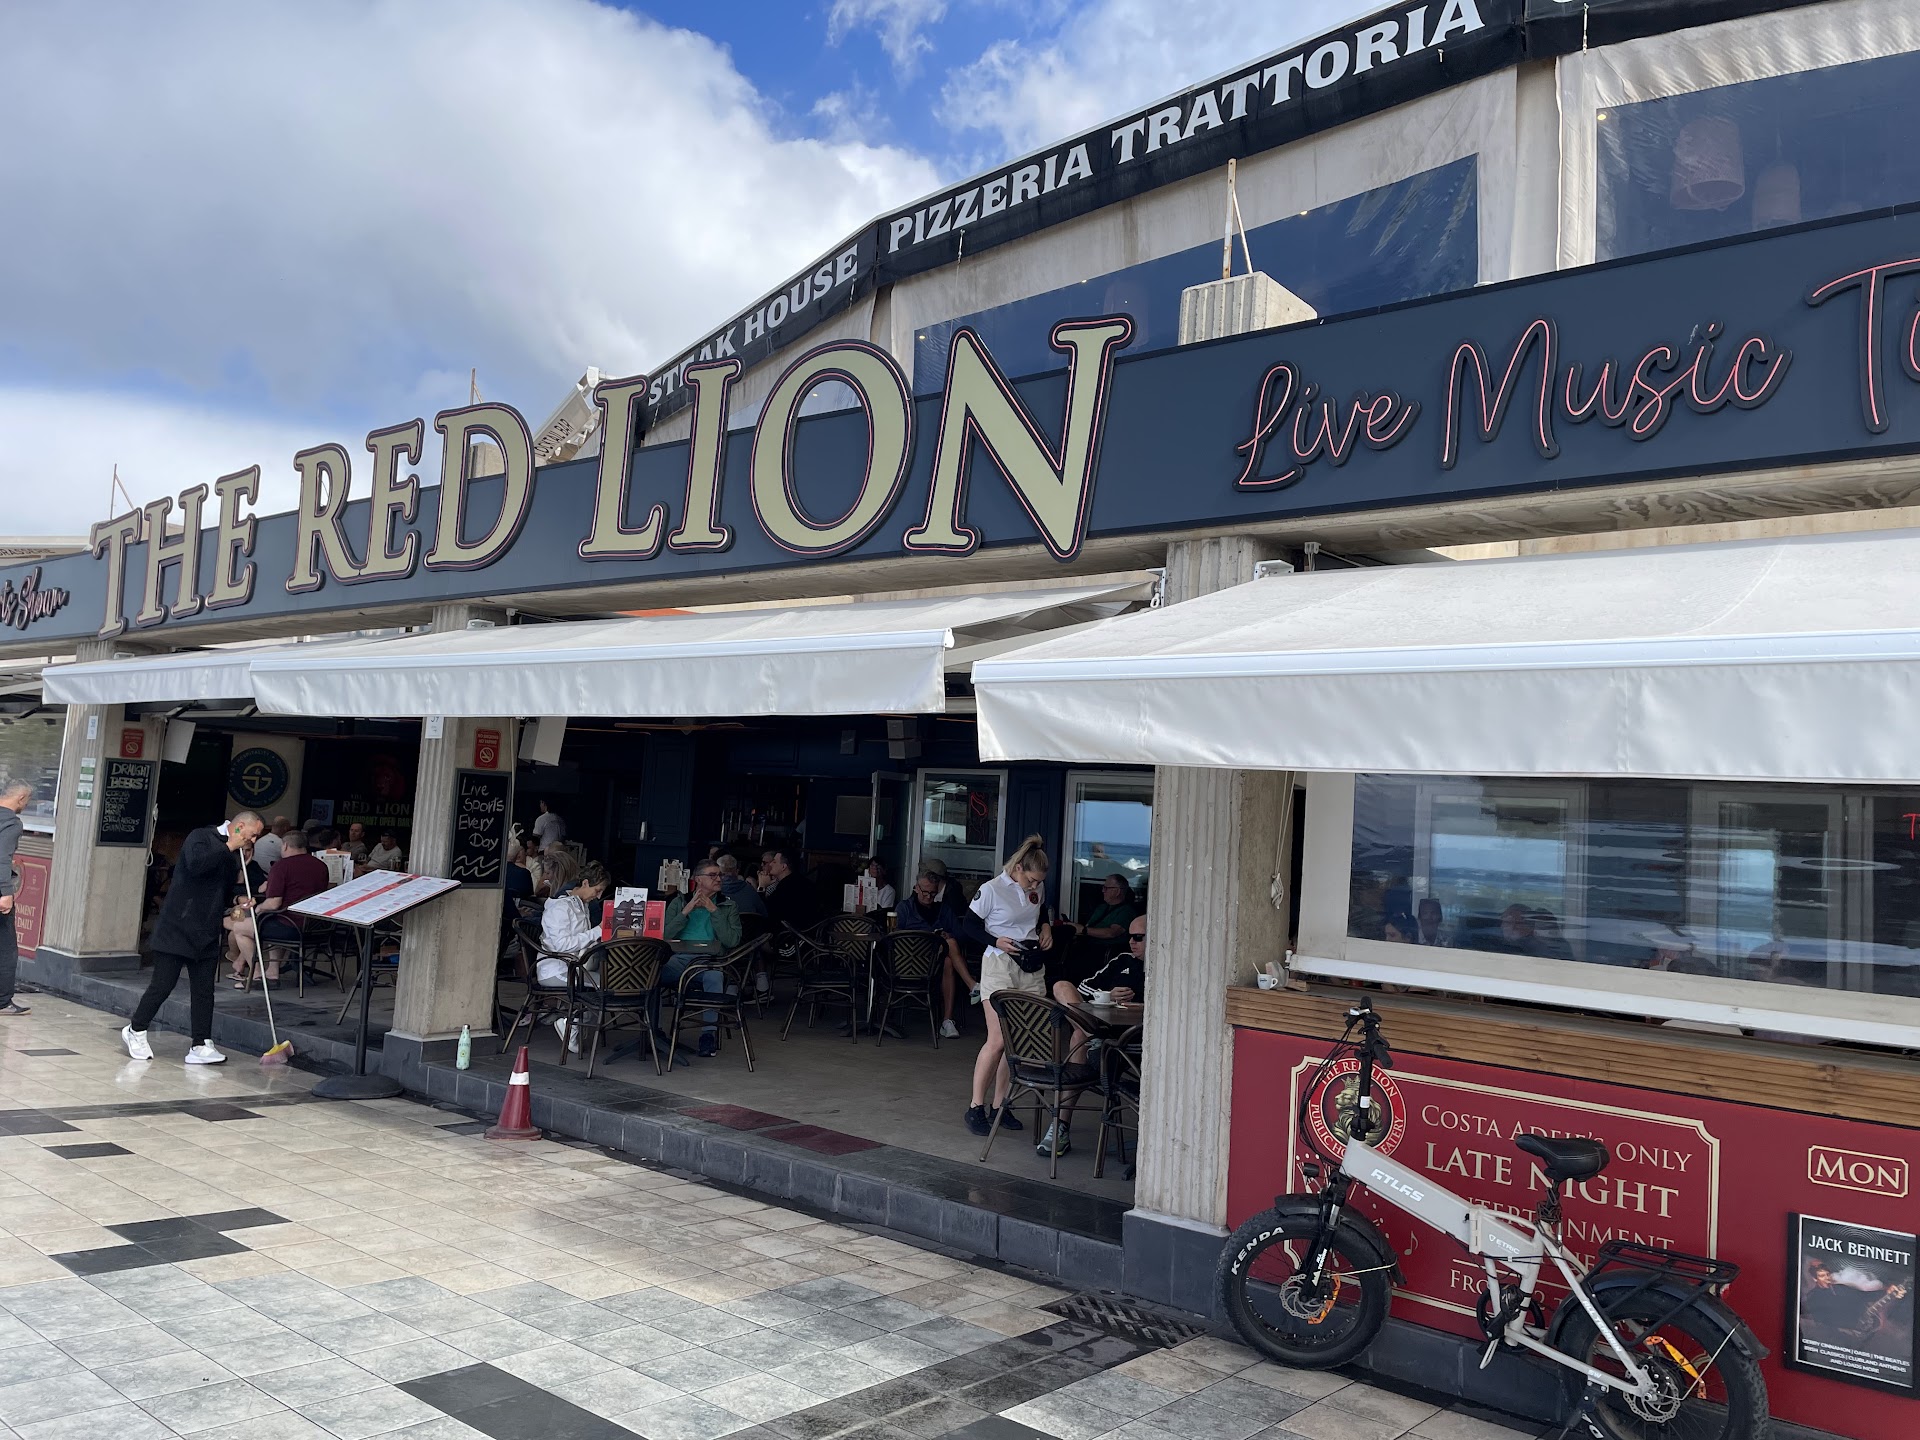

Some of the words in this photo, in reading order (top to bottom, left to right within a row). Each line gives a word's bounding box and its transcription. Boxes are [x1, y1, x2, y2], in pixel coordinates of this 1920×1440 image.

[743, 243, 858, 346] HOUSE
[887, 142, 1094, 254] PIZZERIA
[1111, 0, 1486, 165] TRATTORIA
[1232, 360, 1422, 492] Live
[1440, 314, 1793, 471] Music
[91, 463, 261, 640] THE
[286, 402, 536, 595] RED
[577, 314, 1138, 563] LION
[461, 777, 490, 796] Live
[342, 800, 370, 814] RED
[376, 802, 410, 815] LION
[458, 814, 494, 831] Every
[468, 832, 499, 852] Day
[1371, 1069, 1398, 1098] LION
[1310, 1103, 1332, 1147] PUBLIC
[1380, 1115, 1405, 1155] EATERY
[1425, 1142, 1513, 1186] LATE
[1615, 1142, 1693, 1173] ONLY
[1814, 1153, 1902, 1190] MON
[1370, 1168, 1425, 1202] ATLAS
[1231, 1226, 1285, 1275] KENDA
[1808, 1234, 1843, 1253] JACK
[1847, 1241, 1911, 1266] BENNETT
[1820, 1341, 1851, 1353] CINNAMON
[1854, 1349, 1871, 1358] OASIS
[1873, 1354, 1885, 1362] THE
[1885, 1356, 1911, 1367] BEATLES
[1820, 1349, 1846, 1359] CLASSICS
[1848, 1355, 1879, 1366] CLUBLAND
[1878, 1362, 1907, 1373] ANTHEMS
[1829, 1358, 1843, 1366] AND
[1843, 1361, 1863, 1370] LOADS
[1862, 1366, 1880, 1374] MORE
